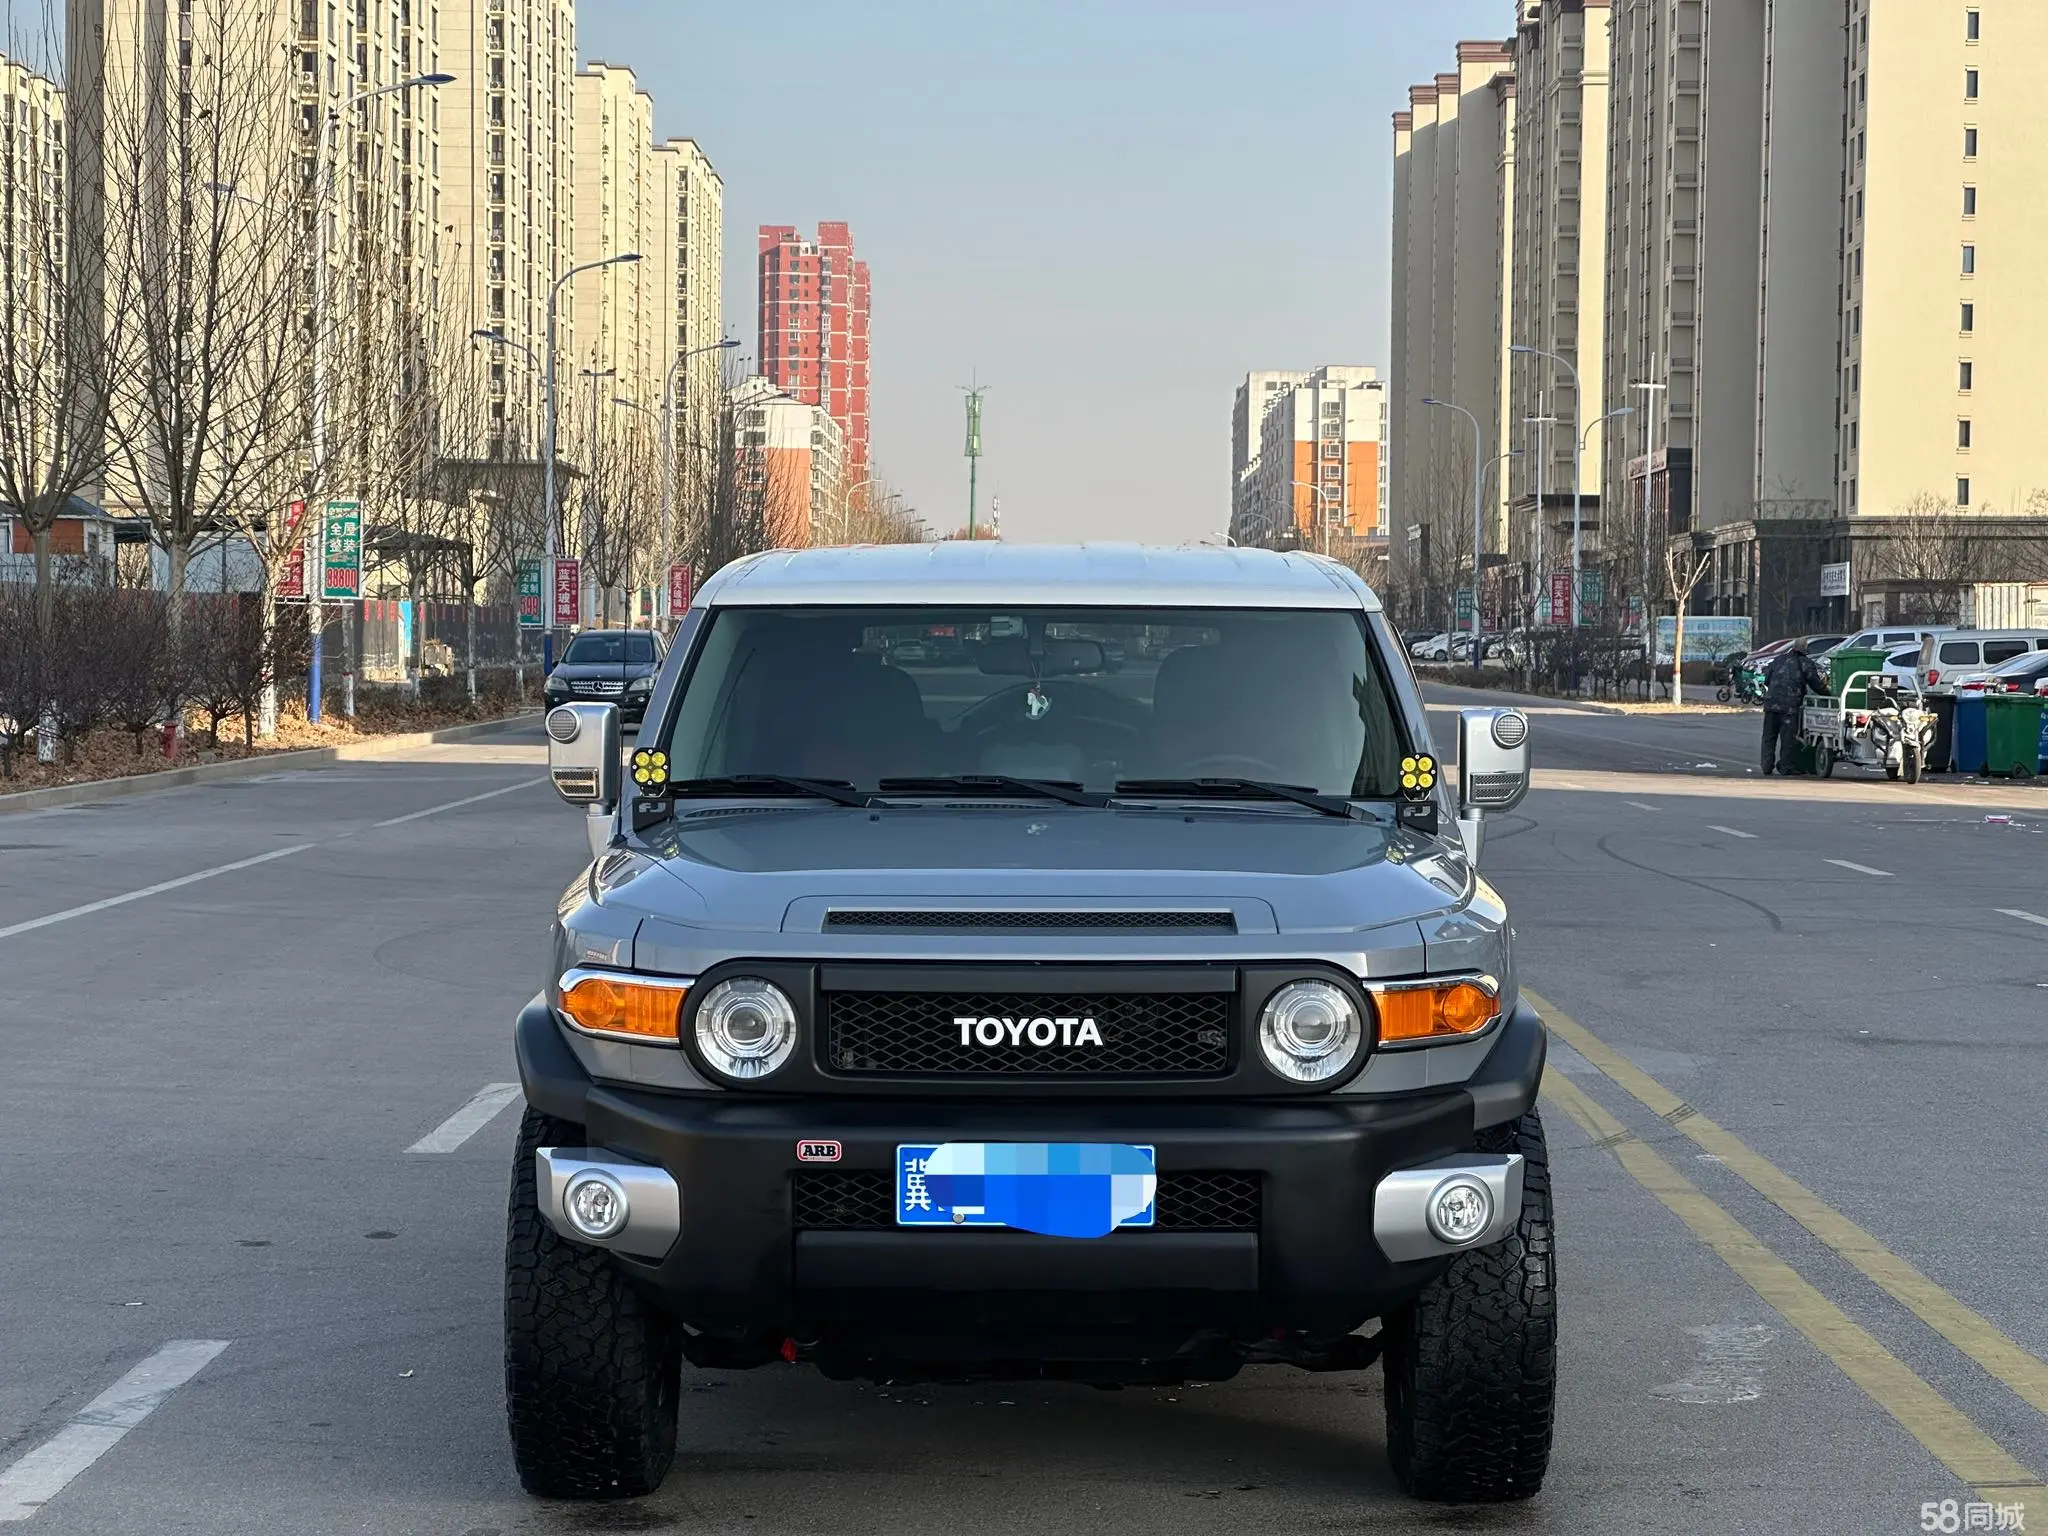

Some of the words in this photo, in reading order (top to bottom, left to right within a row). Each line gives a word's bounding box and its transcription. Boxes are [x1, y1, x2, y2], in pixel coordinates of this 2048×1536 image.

[330, 521, 356, 536] 全屋
[557, 568, 571, 616] 蓝天玻璃
[638, 802, 667, 813] FJ
[1403, 805, 1431, 818] FJ
[953, 1017, 1104, 1047] TOYOTA
[802, 1145, 837, 1157] ARB
